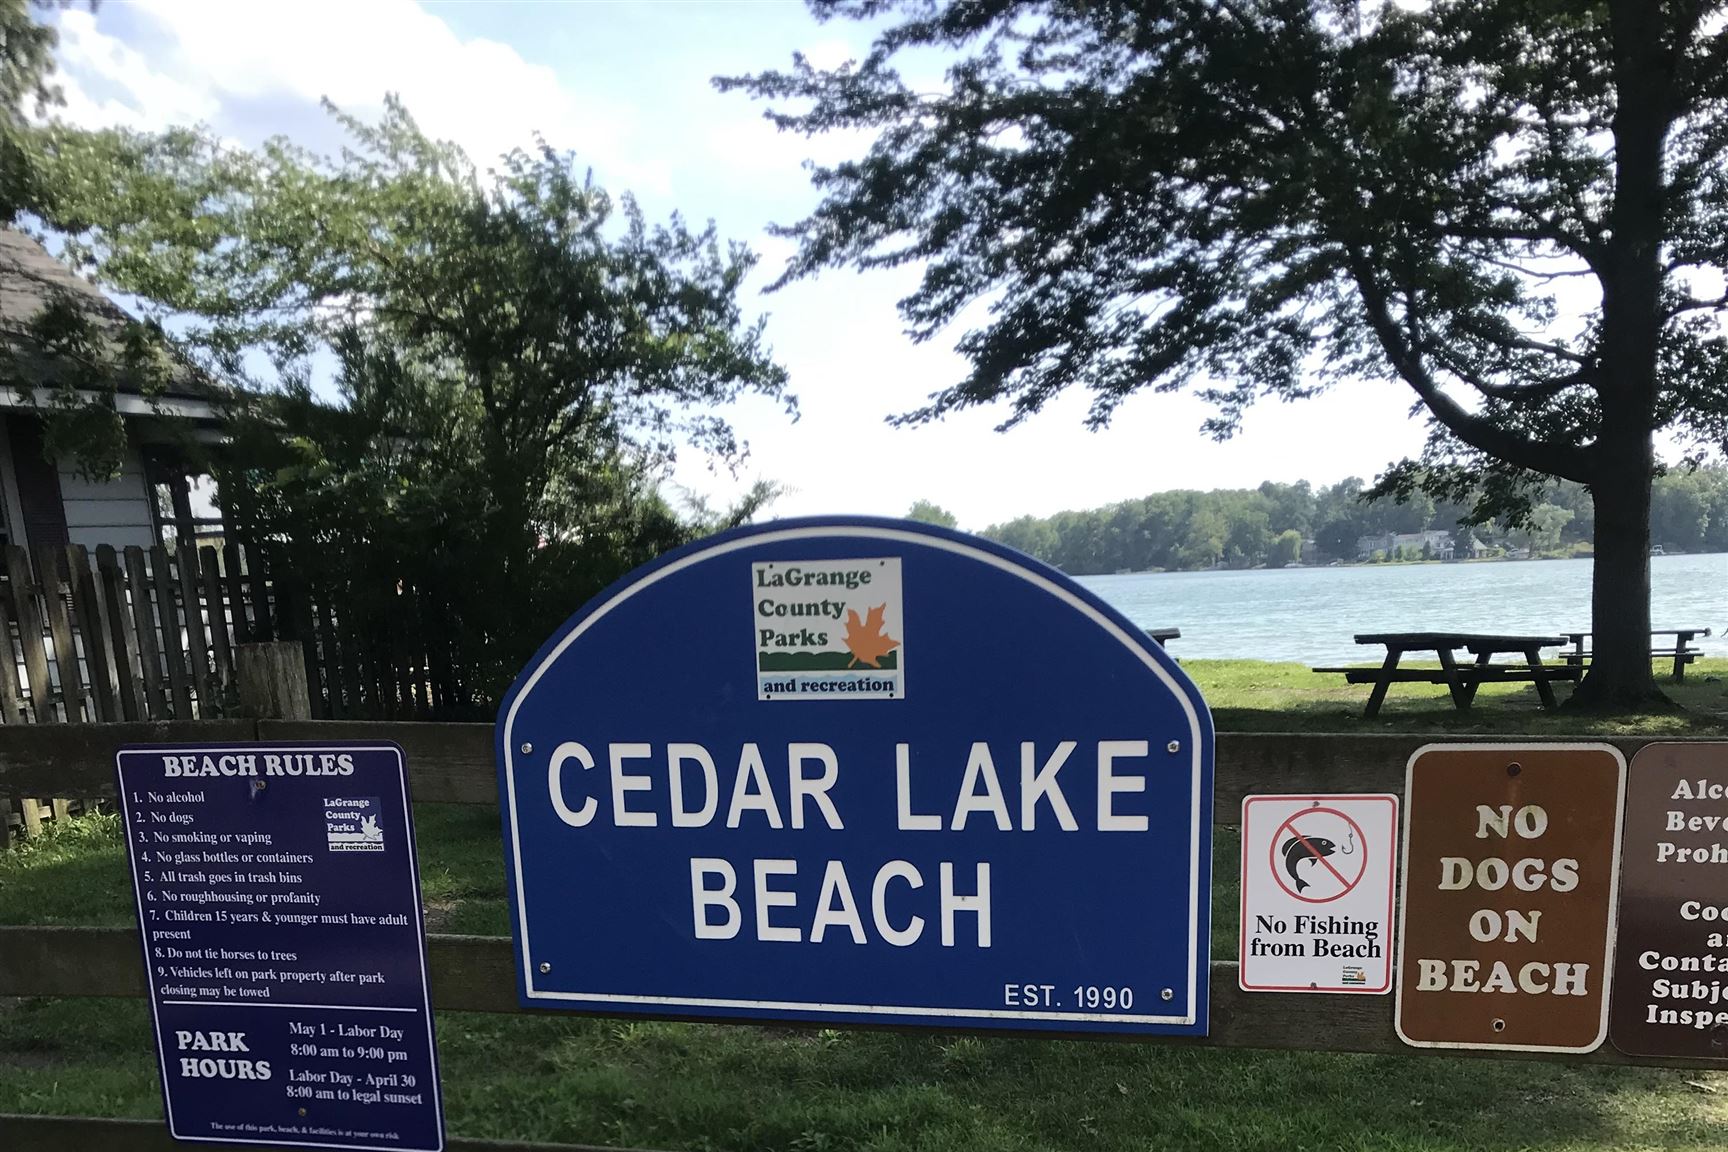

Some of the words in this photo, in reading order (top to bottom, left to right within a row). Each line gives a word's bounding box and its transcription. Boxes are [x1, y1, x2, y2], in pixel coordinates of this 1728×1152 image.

[757, 568, 871, 589] LaGrange
[758, 599, 846, 619] County
[760, 628, 828, 647] Parks
[764, 679, 796, 692] and
[801, 678, 894, 692] recreation
[163, 755, 258, 776] BEACH
[264, 754, 354, 776] RULES
[549, 742, 844, 829] CEDAR
[896, 741, 1148, 831] LAKE
[1671, 780, 1728, 799] Alc
[134, 792, 142, 802] 1.
[148, 792, 163, 802] No
[167, 792, 204, 802] alcohol
[324, 798, 369, 808] LaGrange
[136, 812, 145, 822] 2.
[151, 812, 166, 822] No
[169, 812, 193, 825] dogs
[326, 811, 360, 820] County
[1476, 805, 1547, 838] NO
[327, 823, 355, 831] Parks
[139, 832, 148, 842] 3.
[154, 832, 169, 842] No
[172, 832, 217, 844] smoking
[235, 832, 272, 845] vaping
[142, 852, 151, 862] 4.
[157, 851, 172, 862] No
[175, 852, 200, 864] glass
[203, 852, 239, 862] bottles
[257, 852, 313, 863] containers
[145, 871, 153, 881] 5.
[160, 871, 175, 881] All
[178, 871, 206, 881] trash
[209, 874, 232, 884] goes
[235, 872, 245, 882] in
[248, 872, 276, 882] trash
[279, 872, 302, 883] bins
[1438, 858, 1578, 892] DOGS
[147, 891, 156, 901] 6.
[162, 891, 177, 901] No
[181, 891, 253, 904] roughhousing
[271, 892, 320, 905] profanity
[691, 858, 991, 947] BEACH
[150, 910, 159, 920] 7.
[165, 910, 212, 921] Children
[216, 911, 227, 921] 15
[230, 914, 258, 924] years
[262, 911, 271, 922] &
[275, 915, 318, 925] younger
[321, 914, 348, 923] must
[351, 913, 376, 924] have
[379, 914, 408, 925] adult
[1256, 915, 1286, 934] No
[1294, 915, 1379, 939] Fishing
[1469, 910, 1542, 943] ON
[153, 930, 191, 941] present
[155, 947, 165, 957] 8.
[168, 948, 182, 957] Do
[185, 949, 202, 958] not
[205, 948, 218, 958] tie
[221, 949, 255, 959] horses
[258, 951, 268, 959] to
[271, 951, 297, 960] trees
[1250, 938, 1305, 957] from
[1312, 938, 1382, 958] Beach
[158, 967, 167, 976] 9.
[170, 967, 213, 977] Vehicles
[215, 968, 232, 978] left
[252, 969, 277, 981] park
[280, 972, 325, 983] property
[330, 971, 356, 981] after
[359, 972, 385, 985] park
[1416, 959, 1589, 995] BEACH
[161, 984, 197, 997] closing
[200, 988, 220, 998] may
[224, 986, 236, 996] be
[239, 987, 270, 997] towed
[1005, 984, 1060, 1006] EST.
[1074, 986, 1132, 1009] 1990
[176, 1031, 249, 1051] PARK
[289, 1022, 315, 1037] May
[321, 1024, 325, 1035] 1
[339, 1024, 376, 1037] Labor
[380, 1026, 402, 1041] Day
[291, 1044, 317, 1055] 8:00
[320, 1048, 339, 1057] am
[343, 1047, 354, 1057] to
[357, 1047, 384, 1059] 9:00
[388, 1052, 407, 1063] pm
[180, 1058, 271, 1080] HOURS
[290, 1069, 326, 1082] Labor
[330, 1071, 352, 1086] Day
[366, 1074, 397, 1088] April
[401, 1075, 415, 1087] 30
[287, 1086, 312, 1097] 8:00
[316, 1090, 334, 1099] am
[338, 1090, 349, 1100] to
[352, 1089, 380, 1104] legal
[384, 1094, 422, 1104] sunset
[210, 1122, 223, 1130] The
[236, 1123, 245, 1131] of
[345, 1129, 352, 1137] at
[352, 1131, 368, 1139] your
